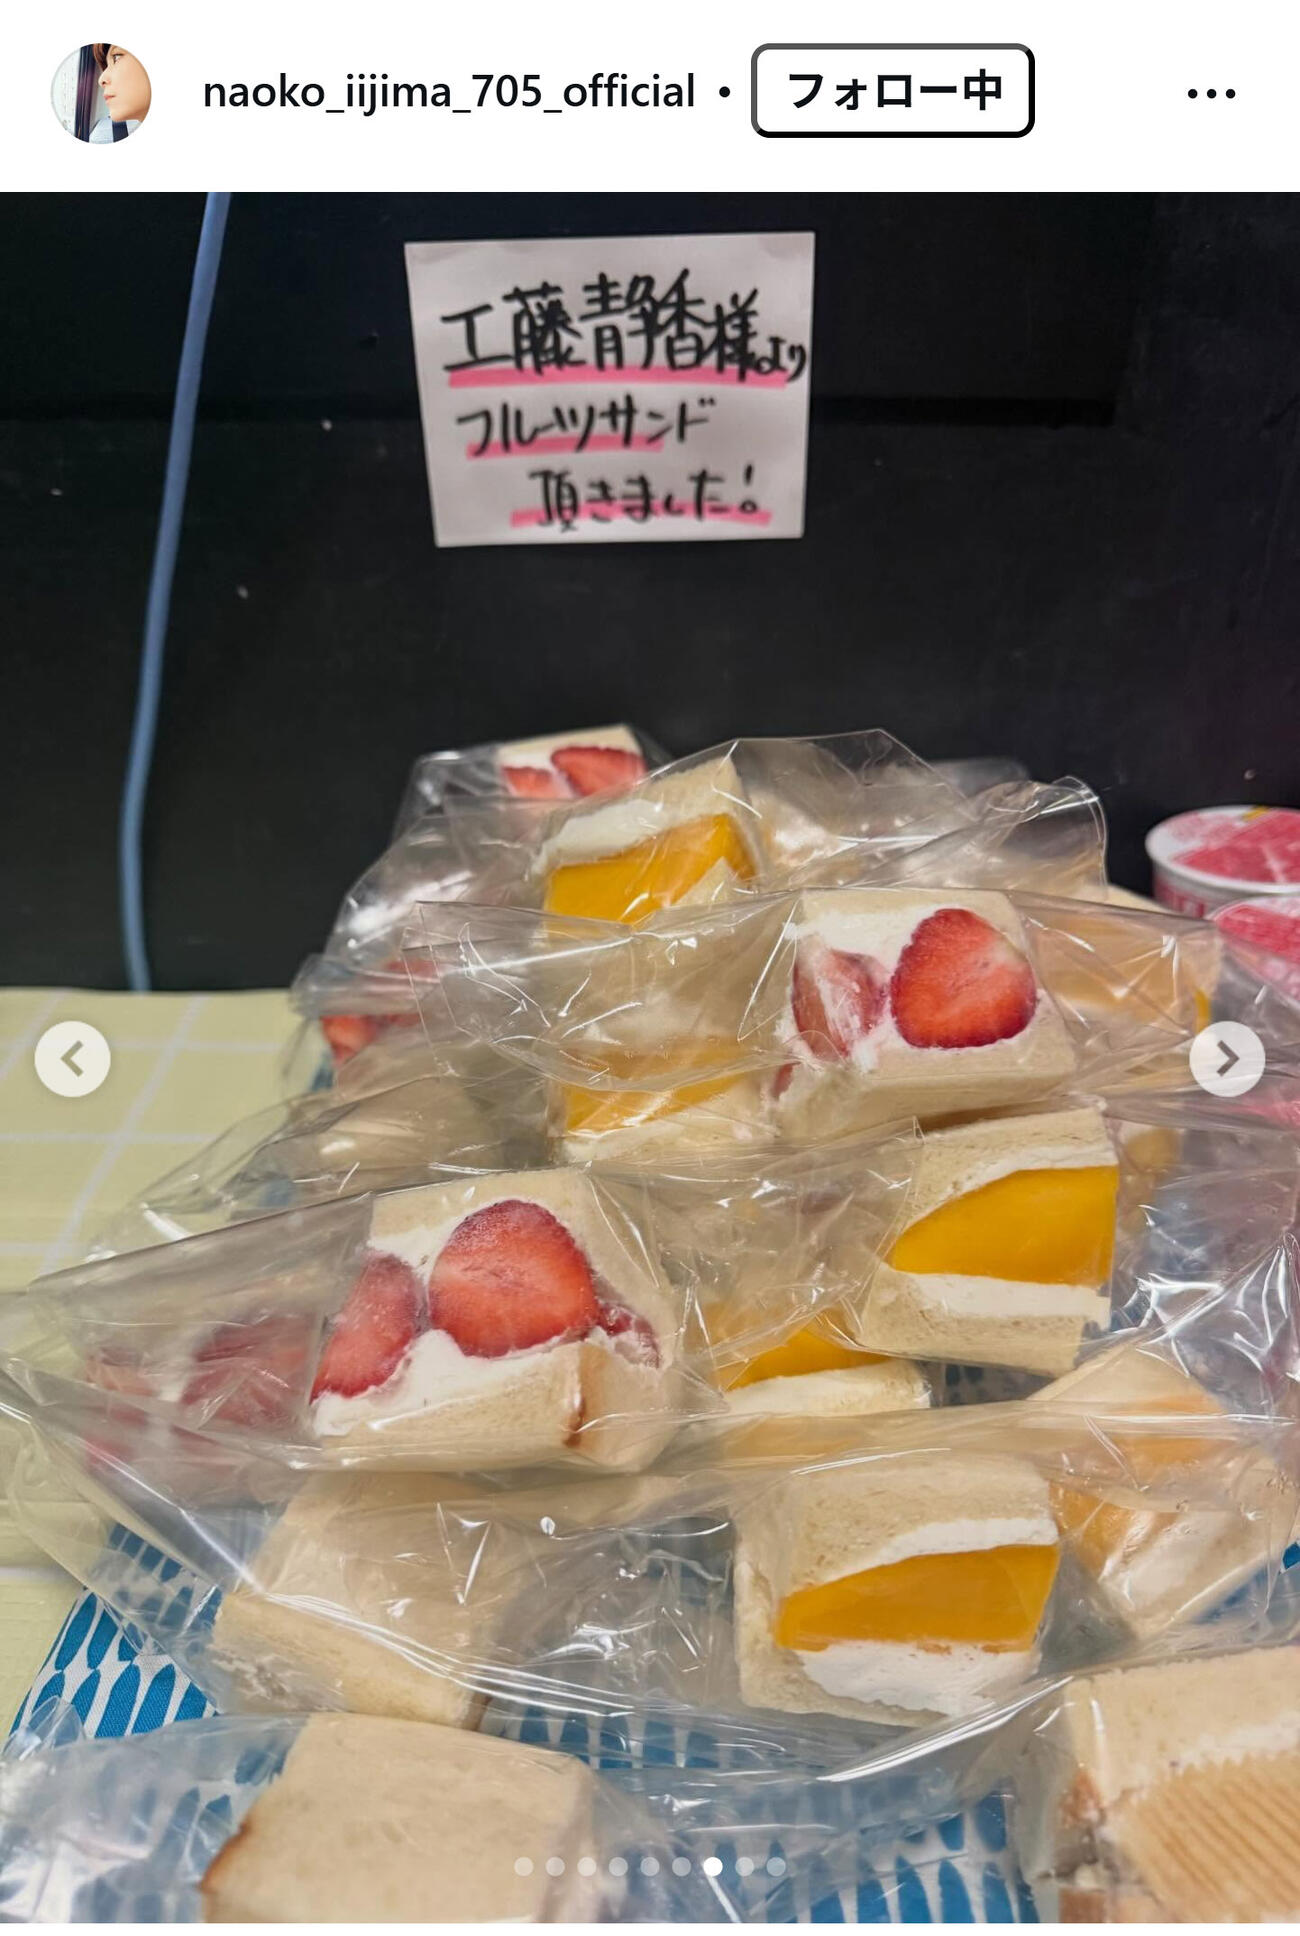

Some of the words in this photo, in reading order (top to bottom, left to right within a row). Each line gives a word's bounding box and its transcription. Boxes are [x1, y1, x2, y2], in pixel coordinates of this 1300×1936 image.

[456, 394, 716, 457] フルーツサンド
